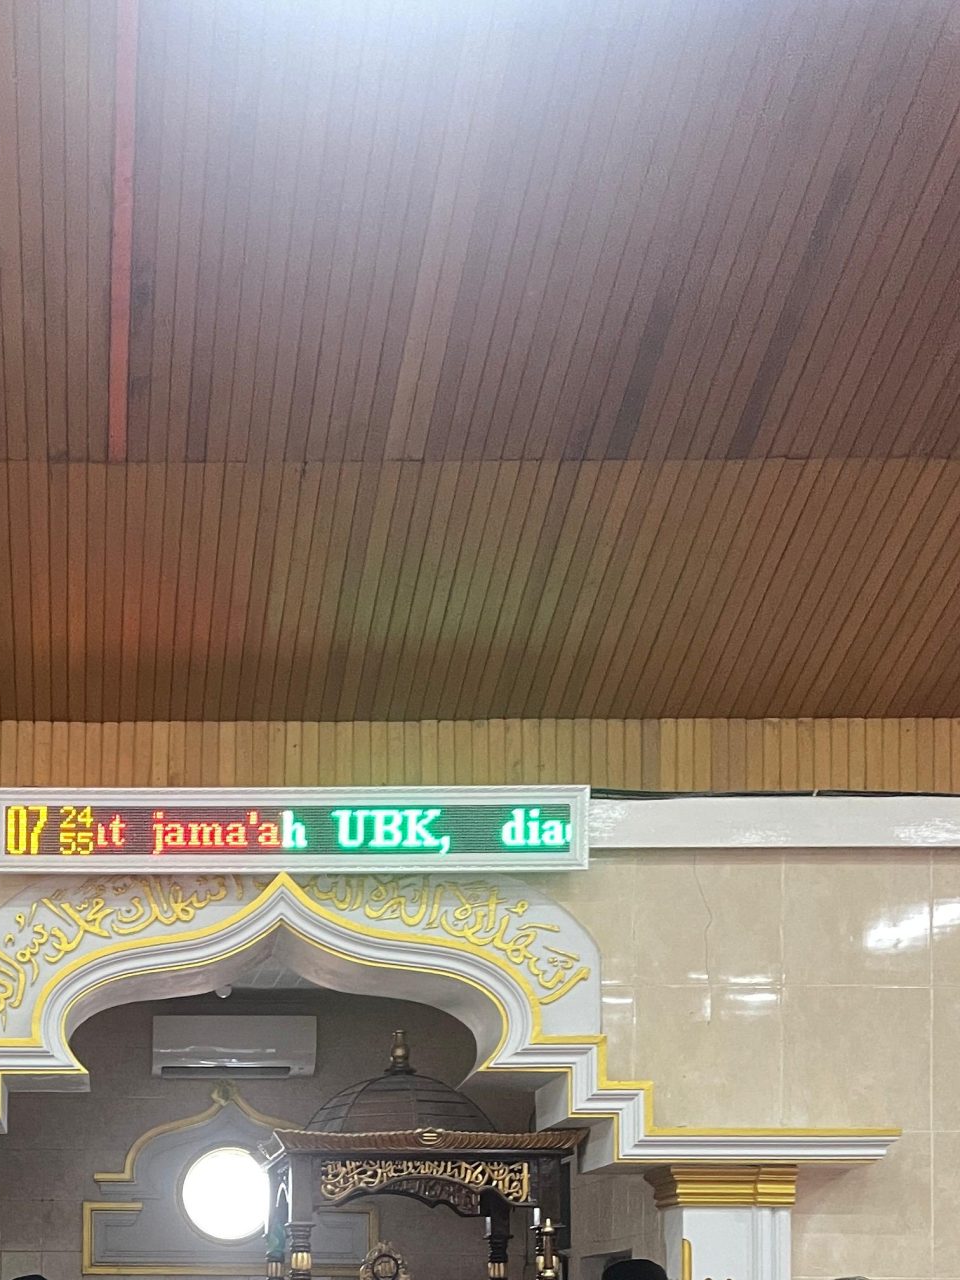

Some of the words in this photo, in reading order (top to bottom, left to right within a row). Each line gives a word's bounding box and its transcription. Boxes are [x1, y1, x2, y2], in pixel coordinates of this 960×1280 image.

[7, 805, 48, 854] 07
[59, 806, 93, 828] 24
[152, 810, 308, 854] jama'ah
[331, 808, 450, 854] UBK,
[59, 832, 93, 854] 55
